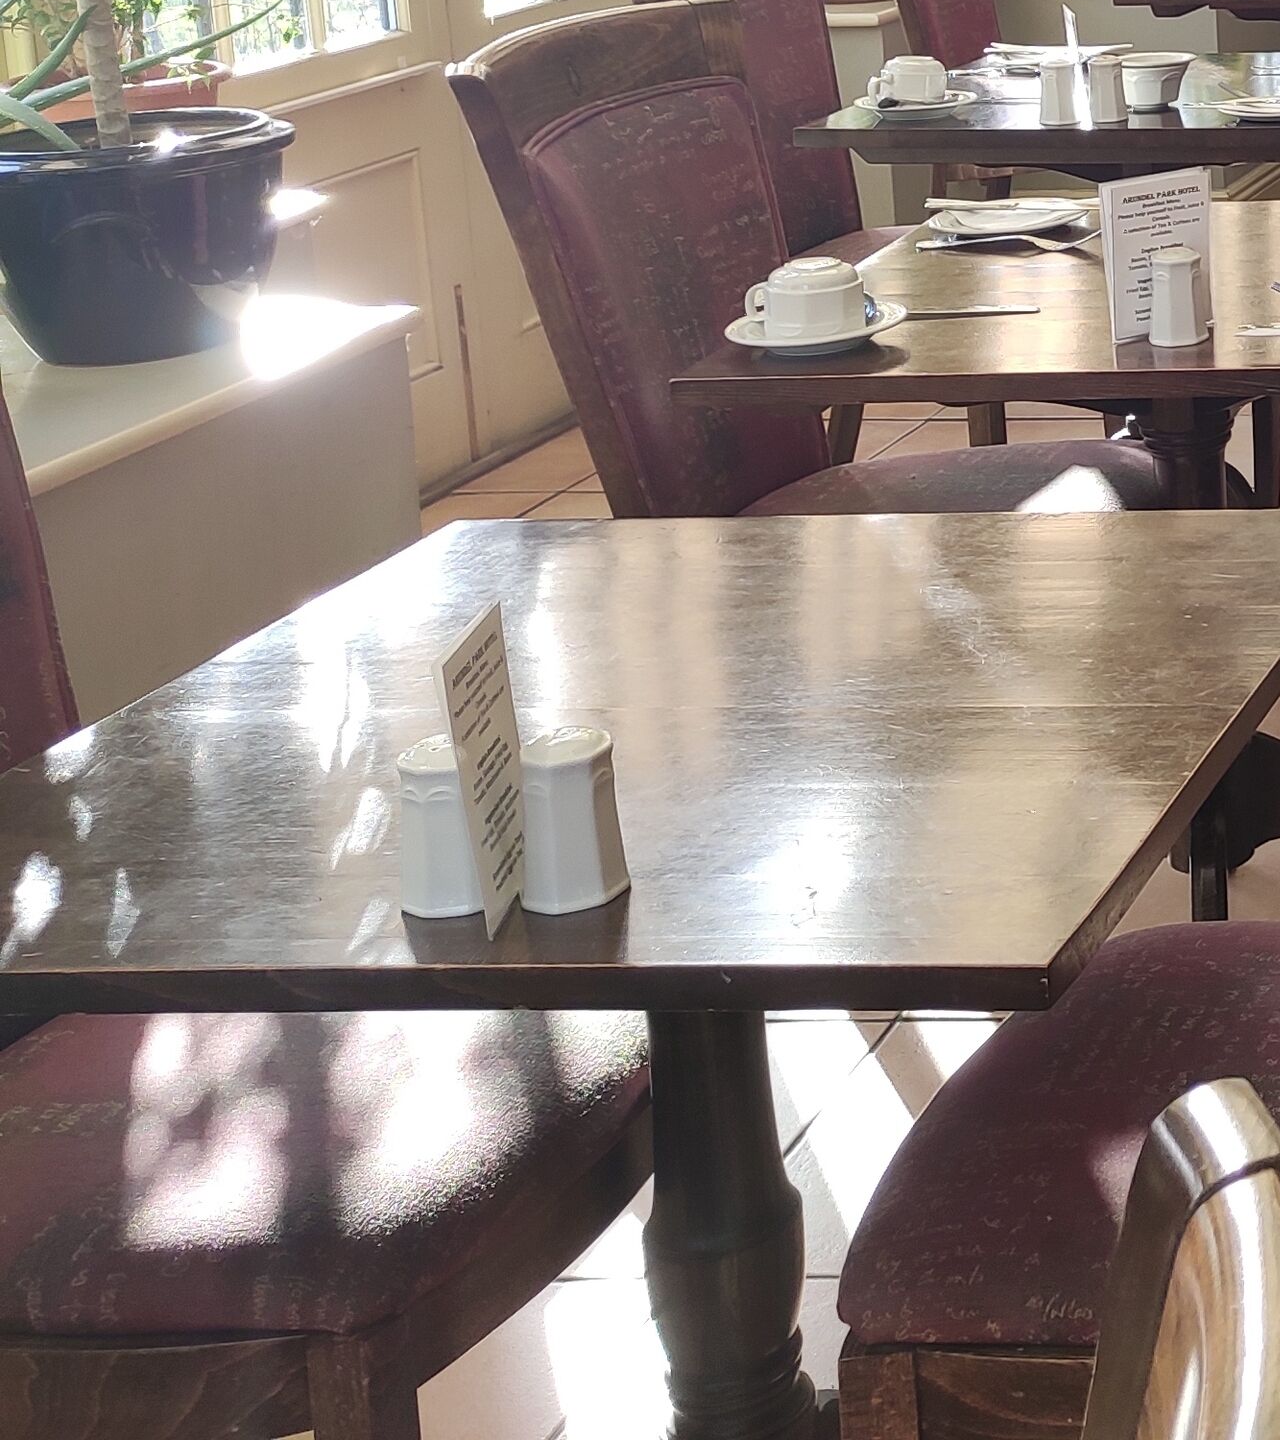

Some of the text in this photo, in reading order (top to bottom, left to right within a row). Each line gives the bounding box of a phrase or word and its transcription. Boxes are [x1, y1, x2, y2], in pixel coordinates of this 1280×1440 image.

[1122, 185, 1201, 204] ARUNDEL PARK HOTEL
